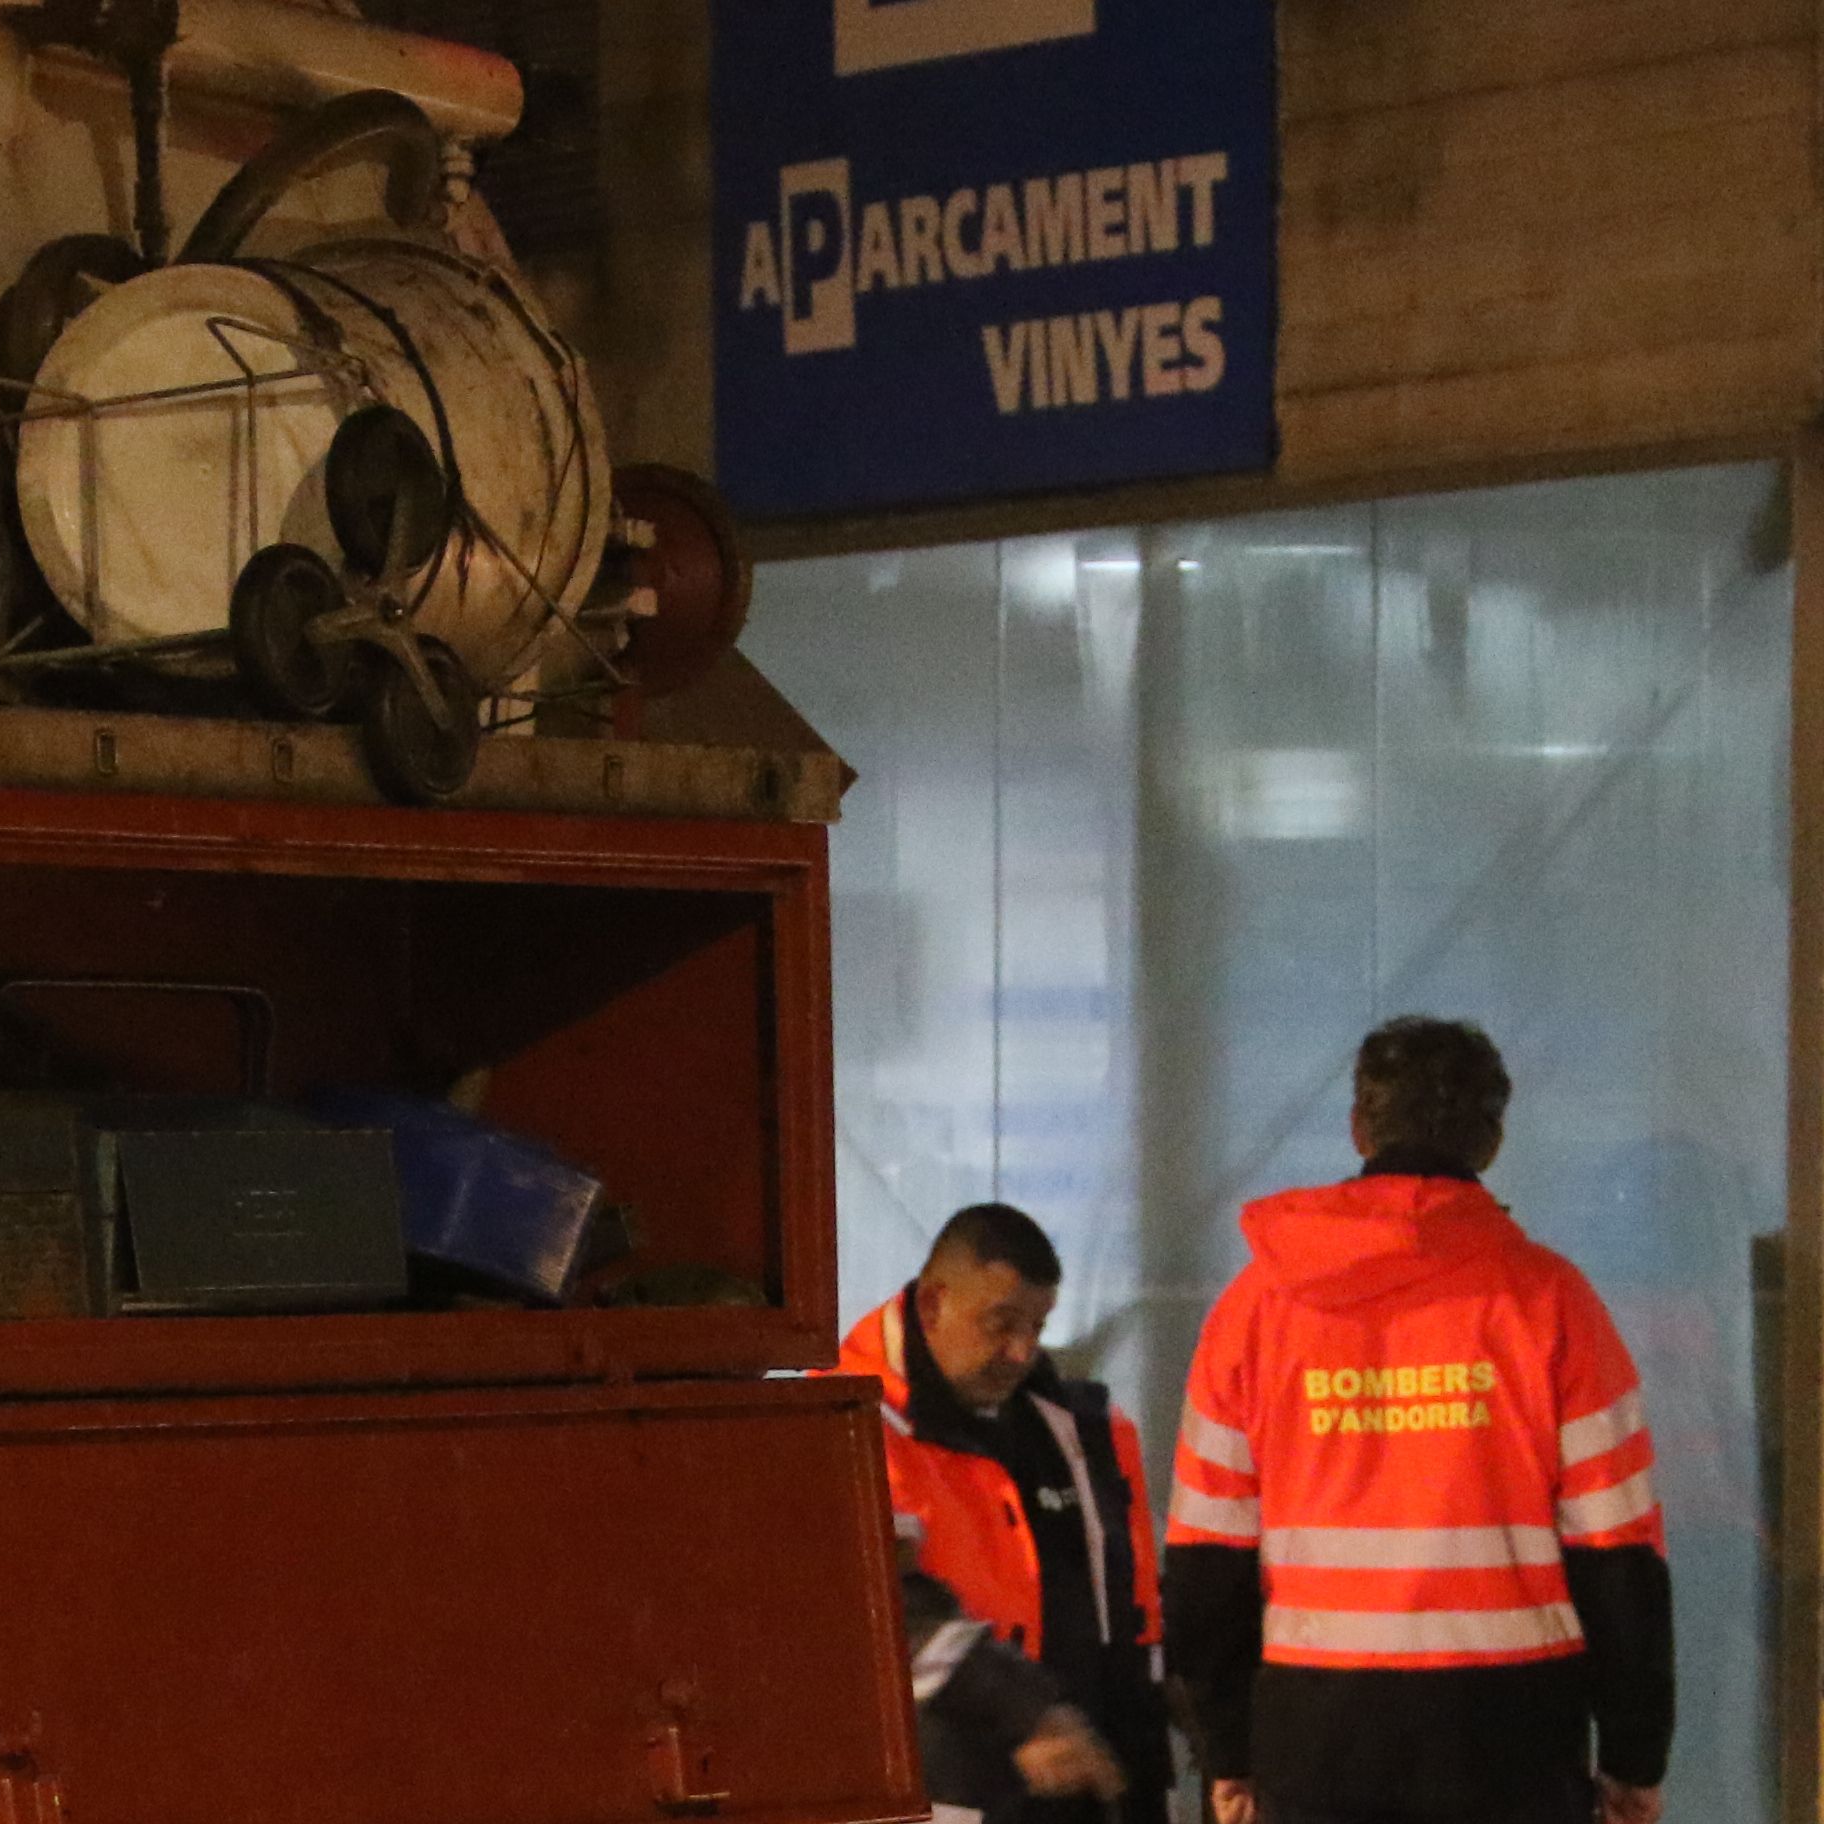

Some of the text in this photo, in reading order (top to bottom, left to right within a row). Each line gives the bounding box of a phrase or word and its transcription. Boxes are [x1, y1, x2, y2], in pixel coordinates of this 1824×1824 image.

[740, 152, 1228, 354] APARCAMENT
[982, 296, 1227, 414] VINYES
[1304, 1361, 1495, 1400] BOMBERS
[1310, 1401, 1491, 1435] D'ANDORRA
